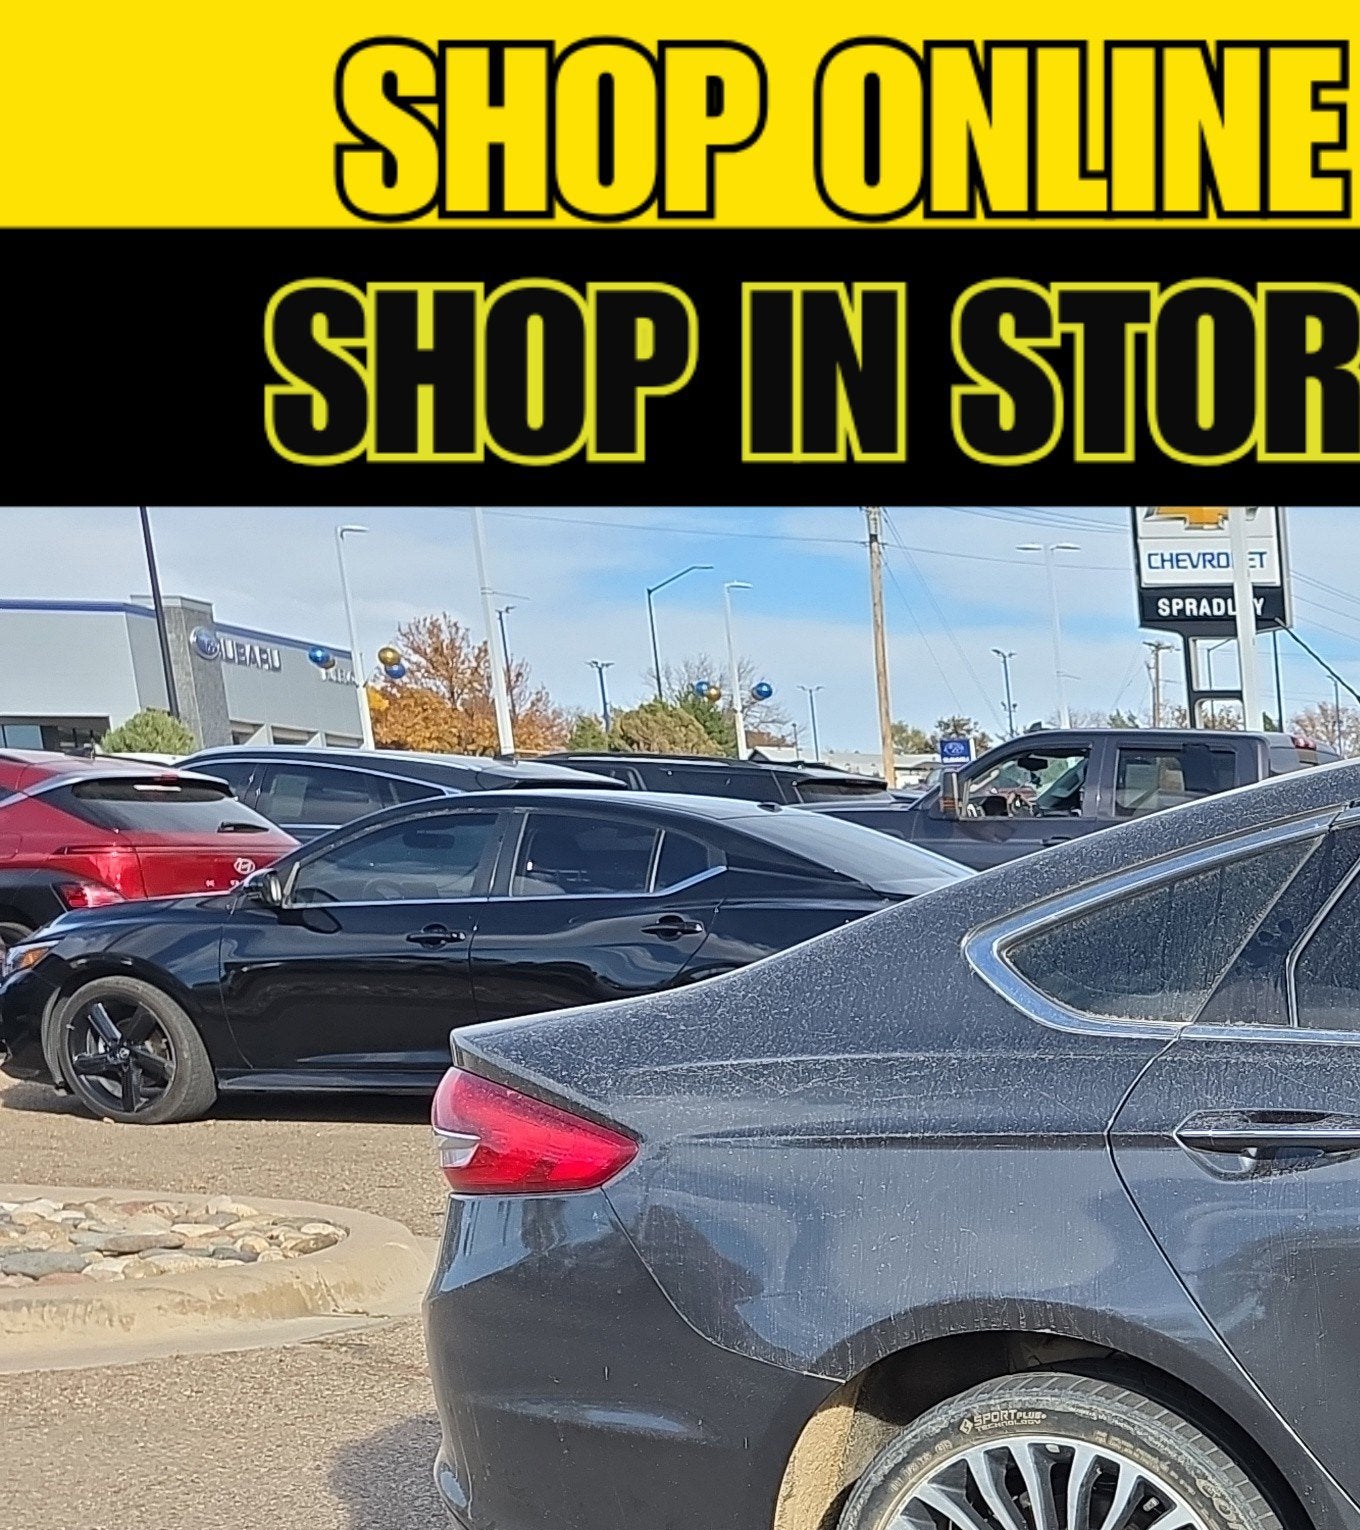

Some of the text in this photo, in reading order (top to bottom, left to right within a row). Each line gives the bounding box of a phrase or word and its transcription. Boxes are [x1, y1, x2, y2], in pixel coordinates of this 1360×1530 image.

[1147, 551, 1267, 570] CHEVROET
[1157, 597, 1265, 617] SPRADLY
[219, 636, 280, 670] UBARU
